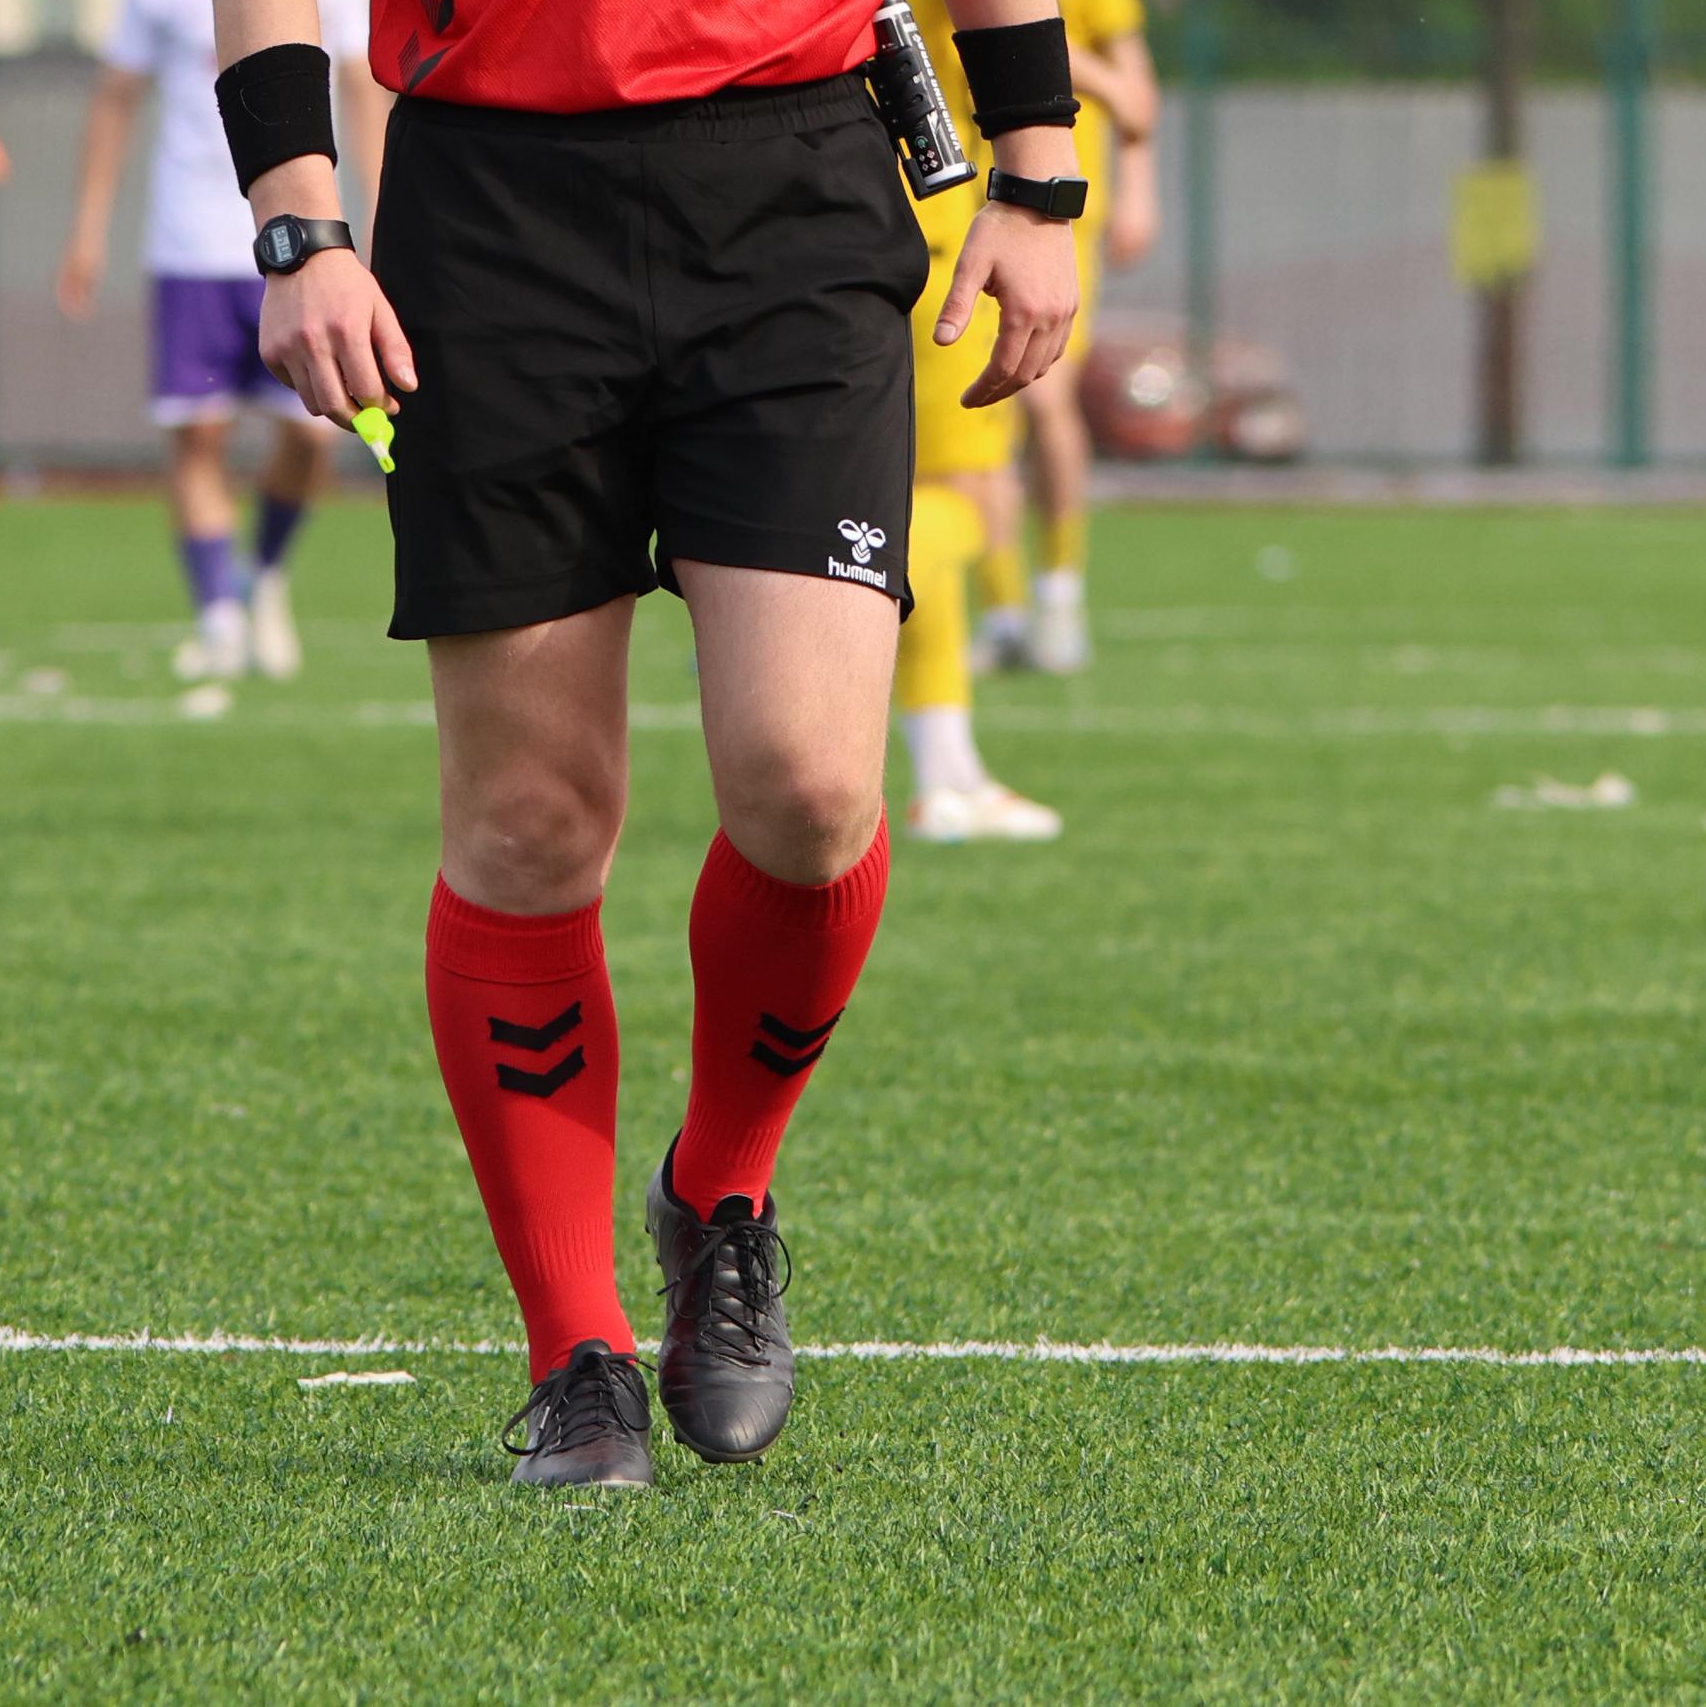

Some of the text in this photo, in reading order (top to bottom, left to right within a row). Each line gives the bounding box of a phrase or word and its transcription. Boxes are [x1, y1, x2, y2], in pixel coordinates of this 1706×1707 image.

[912, 33, 961, 151] VANISHING SPRAY
[827, 555, 887, 589] hummel
